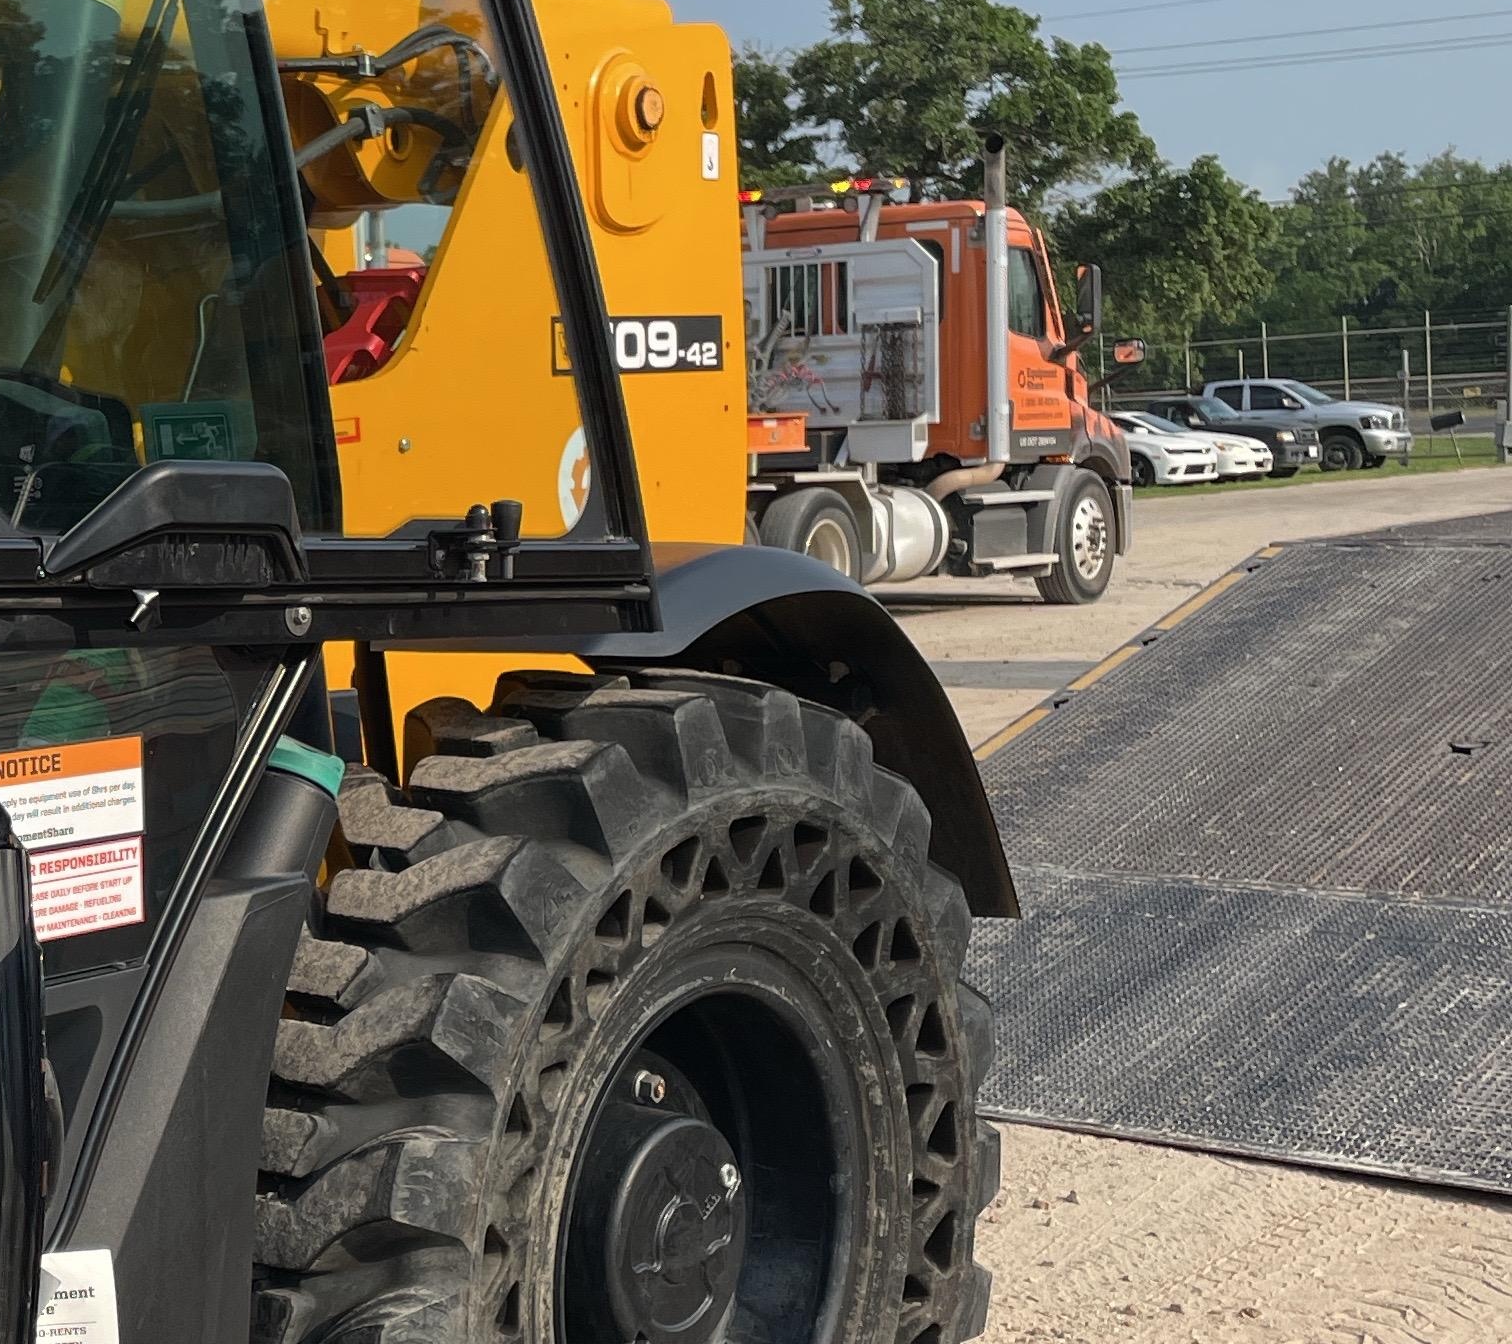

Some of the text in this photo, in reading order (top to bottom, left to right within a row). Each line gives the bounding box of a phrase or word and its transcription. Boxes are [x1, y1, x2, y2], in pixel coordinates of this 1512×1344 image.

[609, 320, 718, 369] 09-42
[29, 847, 137, 876] R RESPONSIBILITY
[73, 882, 99, 895] BEFORE
[100, 878, 122, 890] START
[47, 915, 98, 932] MAINTENANCE
[53, 1286, 95, 1300] ment
